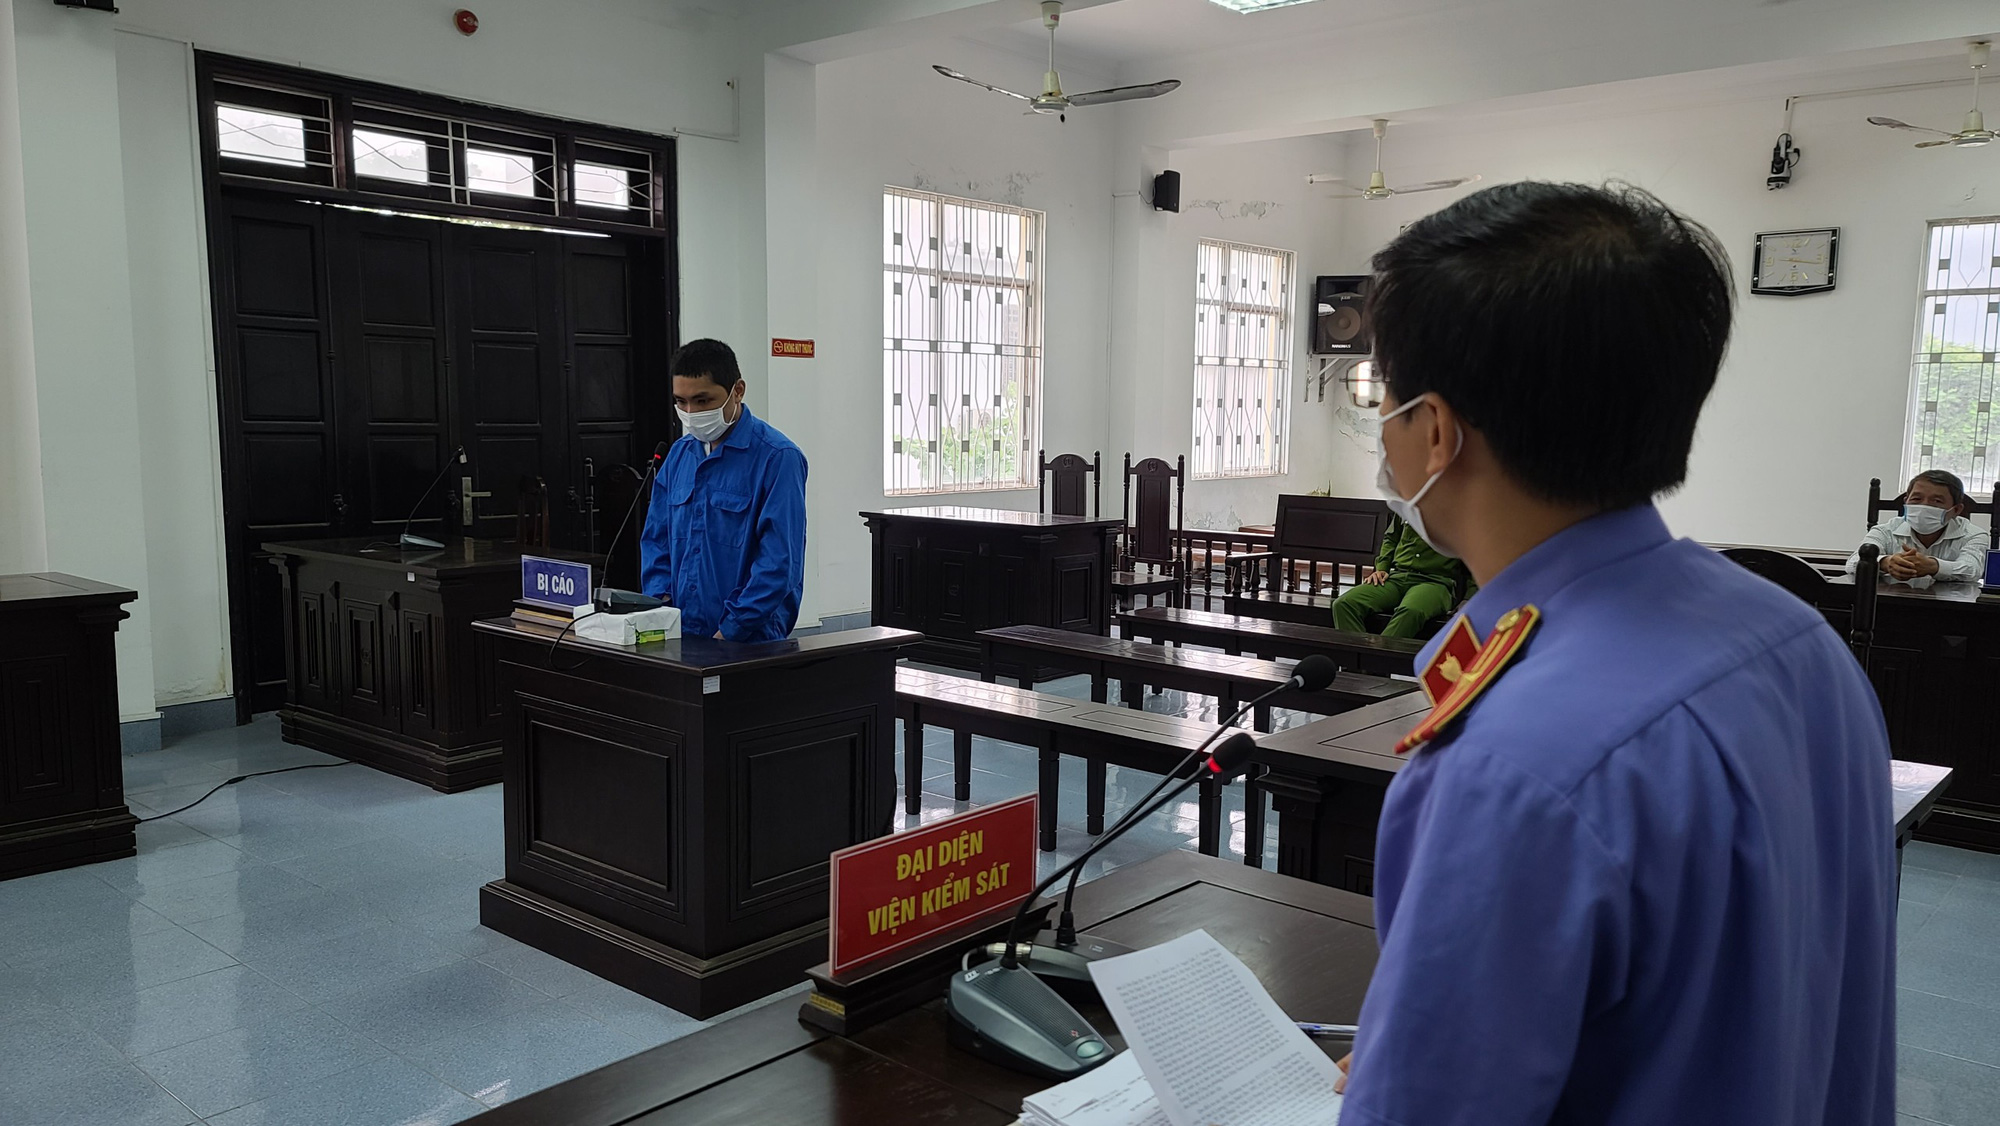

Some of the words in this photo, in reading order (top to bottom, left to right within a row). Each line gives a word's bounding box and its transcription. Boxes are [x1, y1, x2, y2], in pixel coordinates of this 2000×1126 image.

[537, 573, 548, 595] BỊ
[552, 572, 574, 596] CÁO
[896, 845, 933, 882] ĐẠI
[938, 830, 984, 867] DIỆN
[867, 896, 916, 936] VIỆN
[921, 872, 971, 916] KIỂM
[976, 861, 1011, 897] SÁT
